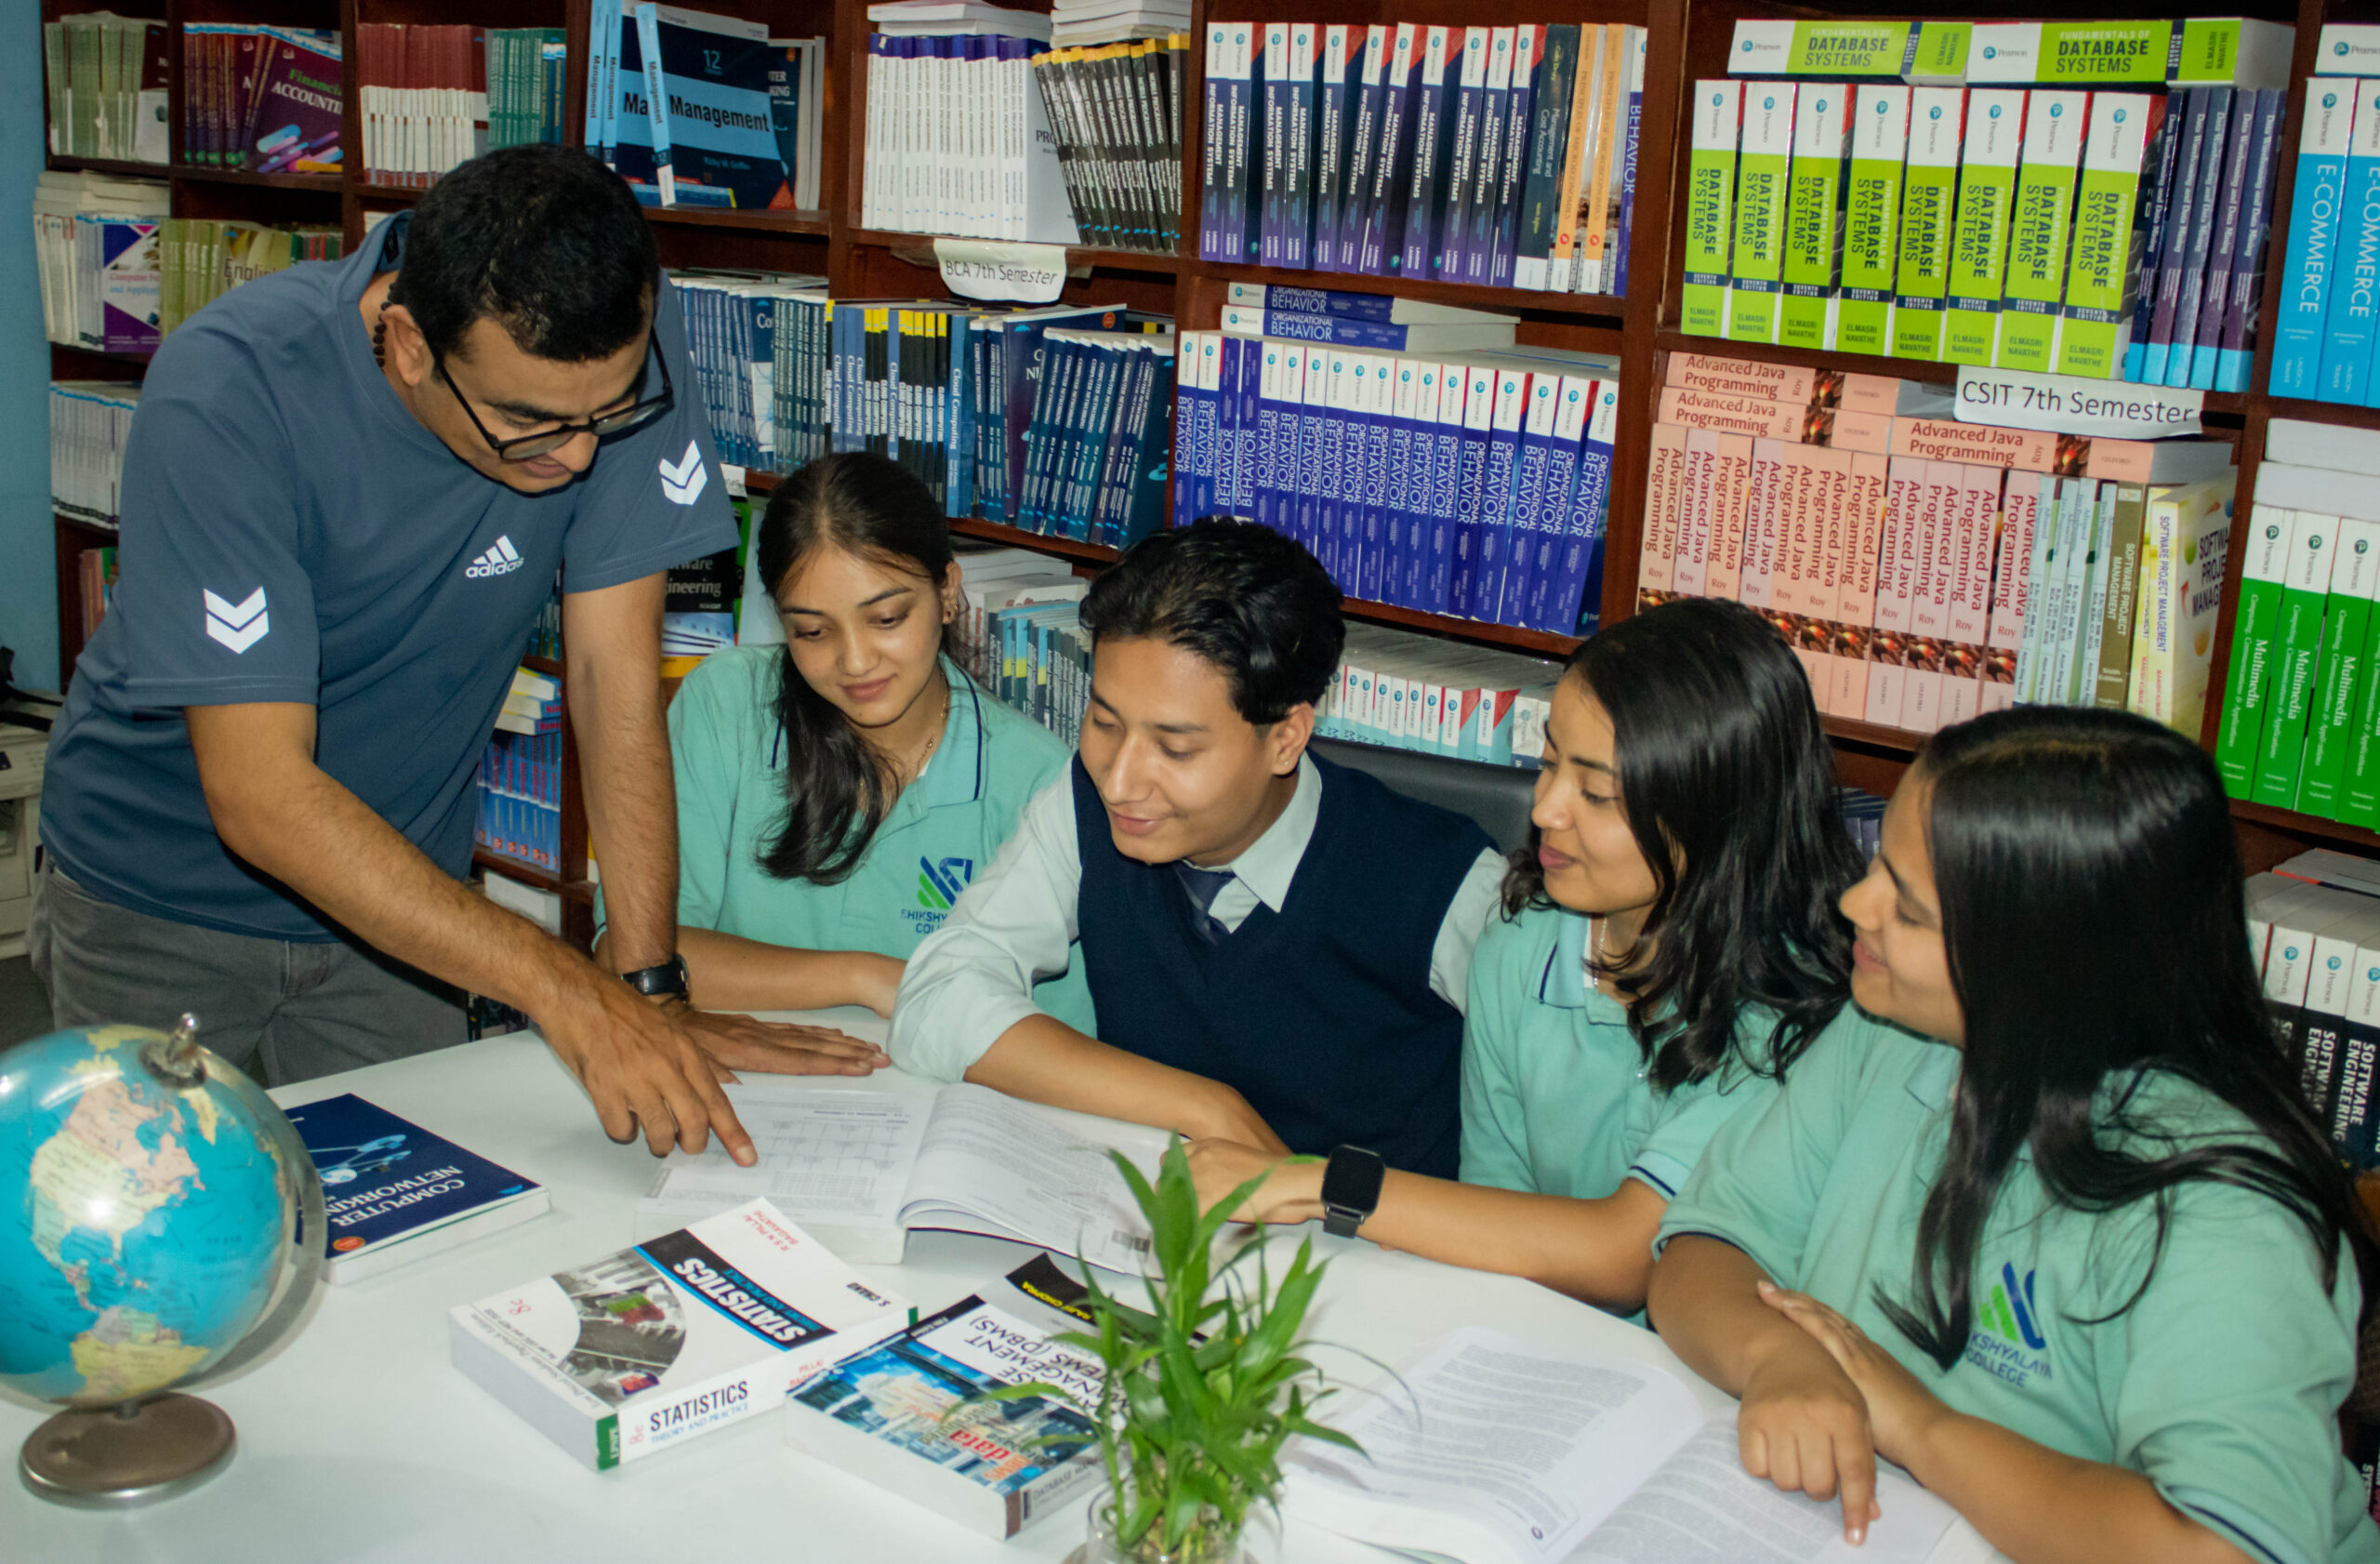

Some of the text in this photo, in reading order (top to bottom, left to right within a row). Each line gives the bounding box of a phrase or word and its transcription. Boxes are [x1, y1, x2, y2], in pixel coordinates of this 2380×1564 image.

[1805, 52, 1872, 67] SYSTEMS
[1807, 37, 1889, 52] DATABASE
[2057, 40, 2149, 56] DATABASE
[2059, 30, 2150, 40] FUNDAMENTALS OF
[2204, 31, 2218, 70] ELMASRI
[2215, 32, 2229, 70] NAVATHE
[289, 68, 342, 97] Financi
[589, 55, 601, 119] Management
[607, 57, 617, 120] Management
[2056, 58, 2132, 73] SYSTEMS
[271, 81, 343, 115] ACCOUNTI
[648, 61, 663, 125] Management
[669, 95, 771, 133] Management
[1206, 84, 1216, 185] INFORMATION SYSTEMS
[1215, 104, 1223, 166] MANAGEMENT
[1289, 86, 1300, 192] INFORMATION SYSTEMS
[1298, 107, 1306, 171] MANAGEMENT
[1451, 92, 1469, 202] INFORMATION SYSTEMS
[1461, 114, 1474, 180] MANAGEMENT
[1622, 104, 1642, 193] BEHAVIOR
[1692, 168, 1709, 240] SYSTEMS
[1703, 169, 1722, 255] DATABASE
[1792, 177, 1810, 251] SYSTEMS
[1805, 178, 1824, 266] DATABASE
[1851, 179, 1871, 255] SYSTEMS
[1863, 179, 1885, 270] DATABASE
[1903, 185, 1924, 262] SYSTEMS
[1918, 186, 1939, 278] DATABASE
[2079, 191, 2104, 272] SYSTEMS
[2092, 192, 2120, 288] DATABASE
[2299, 164, 2337, 313] E-COMMERCE
[2349, 166, 2380, 318] E-COMMERCE
[224, 258, 278, 282] Engli
[945, 259, 1058, 285] BCA 7th Semester
[1271, 296, 1327, 314] BEHAVIOR
[1272, 312, 1333, 326] ORGANIZATIONAL
[1846, 324, 1877, 335] ELMASRI
[1271, 323, 1333, 341] BEHAVIOR
[1845, 334, 1876, 345] NAVATHE
[2008, 346, 2042, 358] NAVATHE
[2009, 336, 2043, 348] ELMASRI
[952, 368, 961, 397] Cloud
[1685, 372, 1779, 401] Programming
[1686, 355, 1786, 380] Advanced Java
[1792, 378, 1804, 397] Roy
[1675, 408, 1771, 437] Programming
[1676, 391, 1777, 418] Advanced Java
[1782, 415, 1794, 434] Roy
[1962, 379, 2195, 424] CSIT 7th Semester
[1174, 396, 1187, 472] BEHAVIOR
[1183, 397, 1195, 473] ORGANIZATIONAL
[1909, 439, 2016, 468] Programming
[1911, 422, 2024, 447] Advanced Java
[2030, 444, 2043, 464] Roy
[1514, 444, 1538, 530] BEHAVIOR
[1527, 447, 1547, 530] ORGANIZATIONAL
[1568, 452, 1600, 538] BEHAVIOR
[1582, 456, 1609, 538] ORGANIZATIONAL
[1645, 447, 1669, 554] Programming
[1661, 447, 1683, 561] Advanced Java
[1915, 484, 1942, 597] Programming
[1934, 485, 1959, 606] Advanced Java
[2200, 526, 2229, 560] SOFTWA
[465, 557, 524, 578] adidas
[667, 578, 722, 597] ineering
[1647, 568, 1664, 580] Roy
[2108, 556, 2122, 620] MANAGEMENT
[2117, 542, 2135, 636] SOFTWARE PROJECT
[2156, 515, 2170, 653] SOFTWARE PROJECT MANAGEMENT
[2202, 554, 2227, 587] PROJE
[1918, 613, 1936, 627] Roy
[2246, 639, 2269, 709] Multimedia
[2287, 649, 2310, 721] Multimedia
[2333, 656, 2357, 727] Multimedia
[2334, 1038, 2363, 1143] ENGINEERING
[2350, 1040, 2376, 1126] SOFTWARE
[325, 1165, 464, 1218] NETWORKIN
[330, 1178, 466, 1227] COMPUTER
[673, 1257, 808, 1342] STATISTICS
[1965, 1346, 2029, 1388] COLLEGE
[1970, 1331, 2053, 1380] KSHYALAYA
[650, 1380, 748, 1433] STATISTICS
[948, 1429, 1011, 1461] data
[984, 1454, 1032, 1481] DBMS
